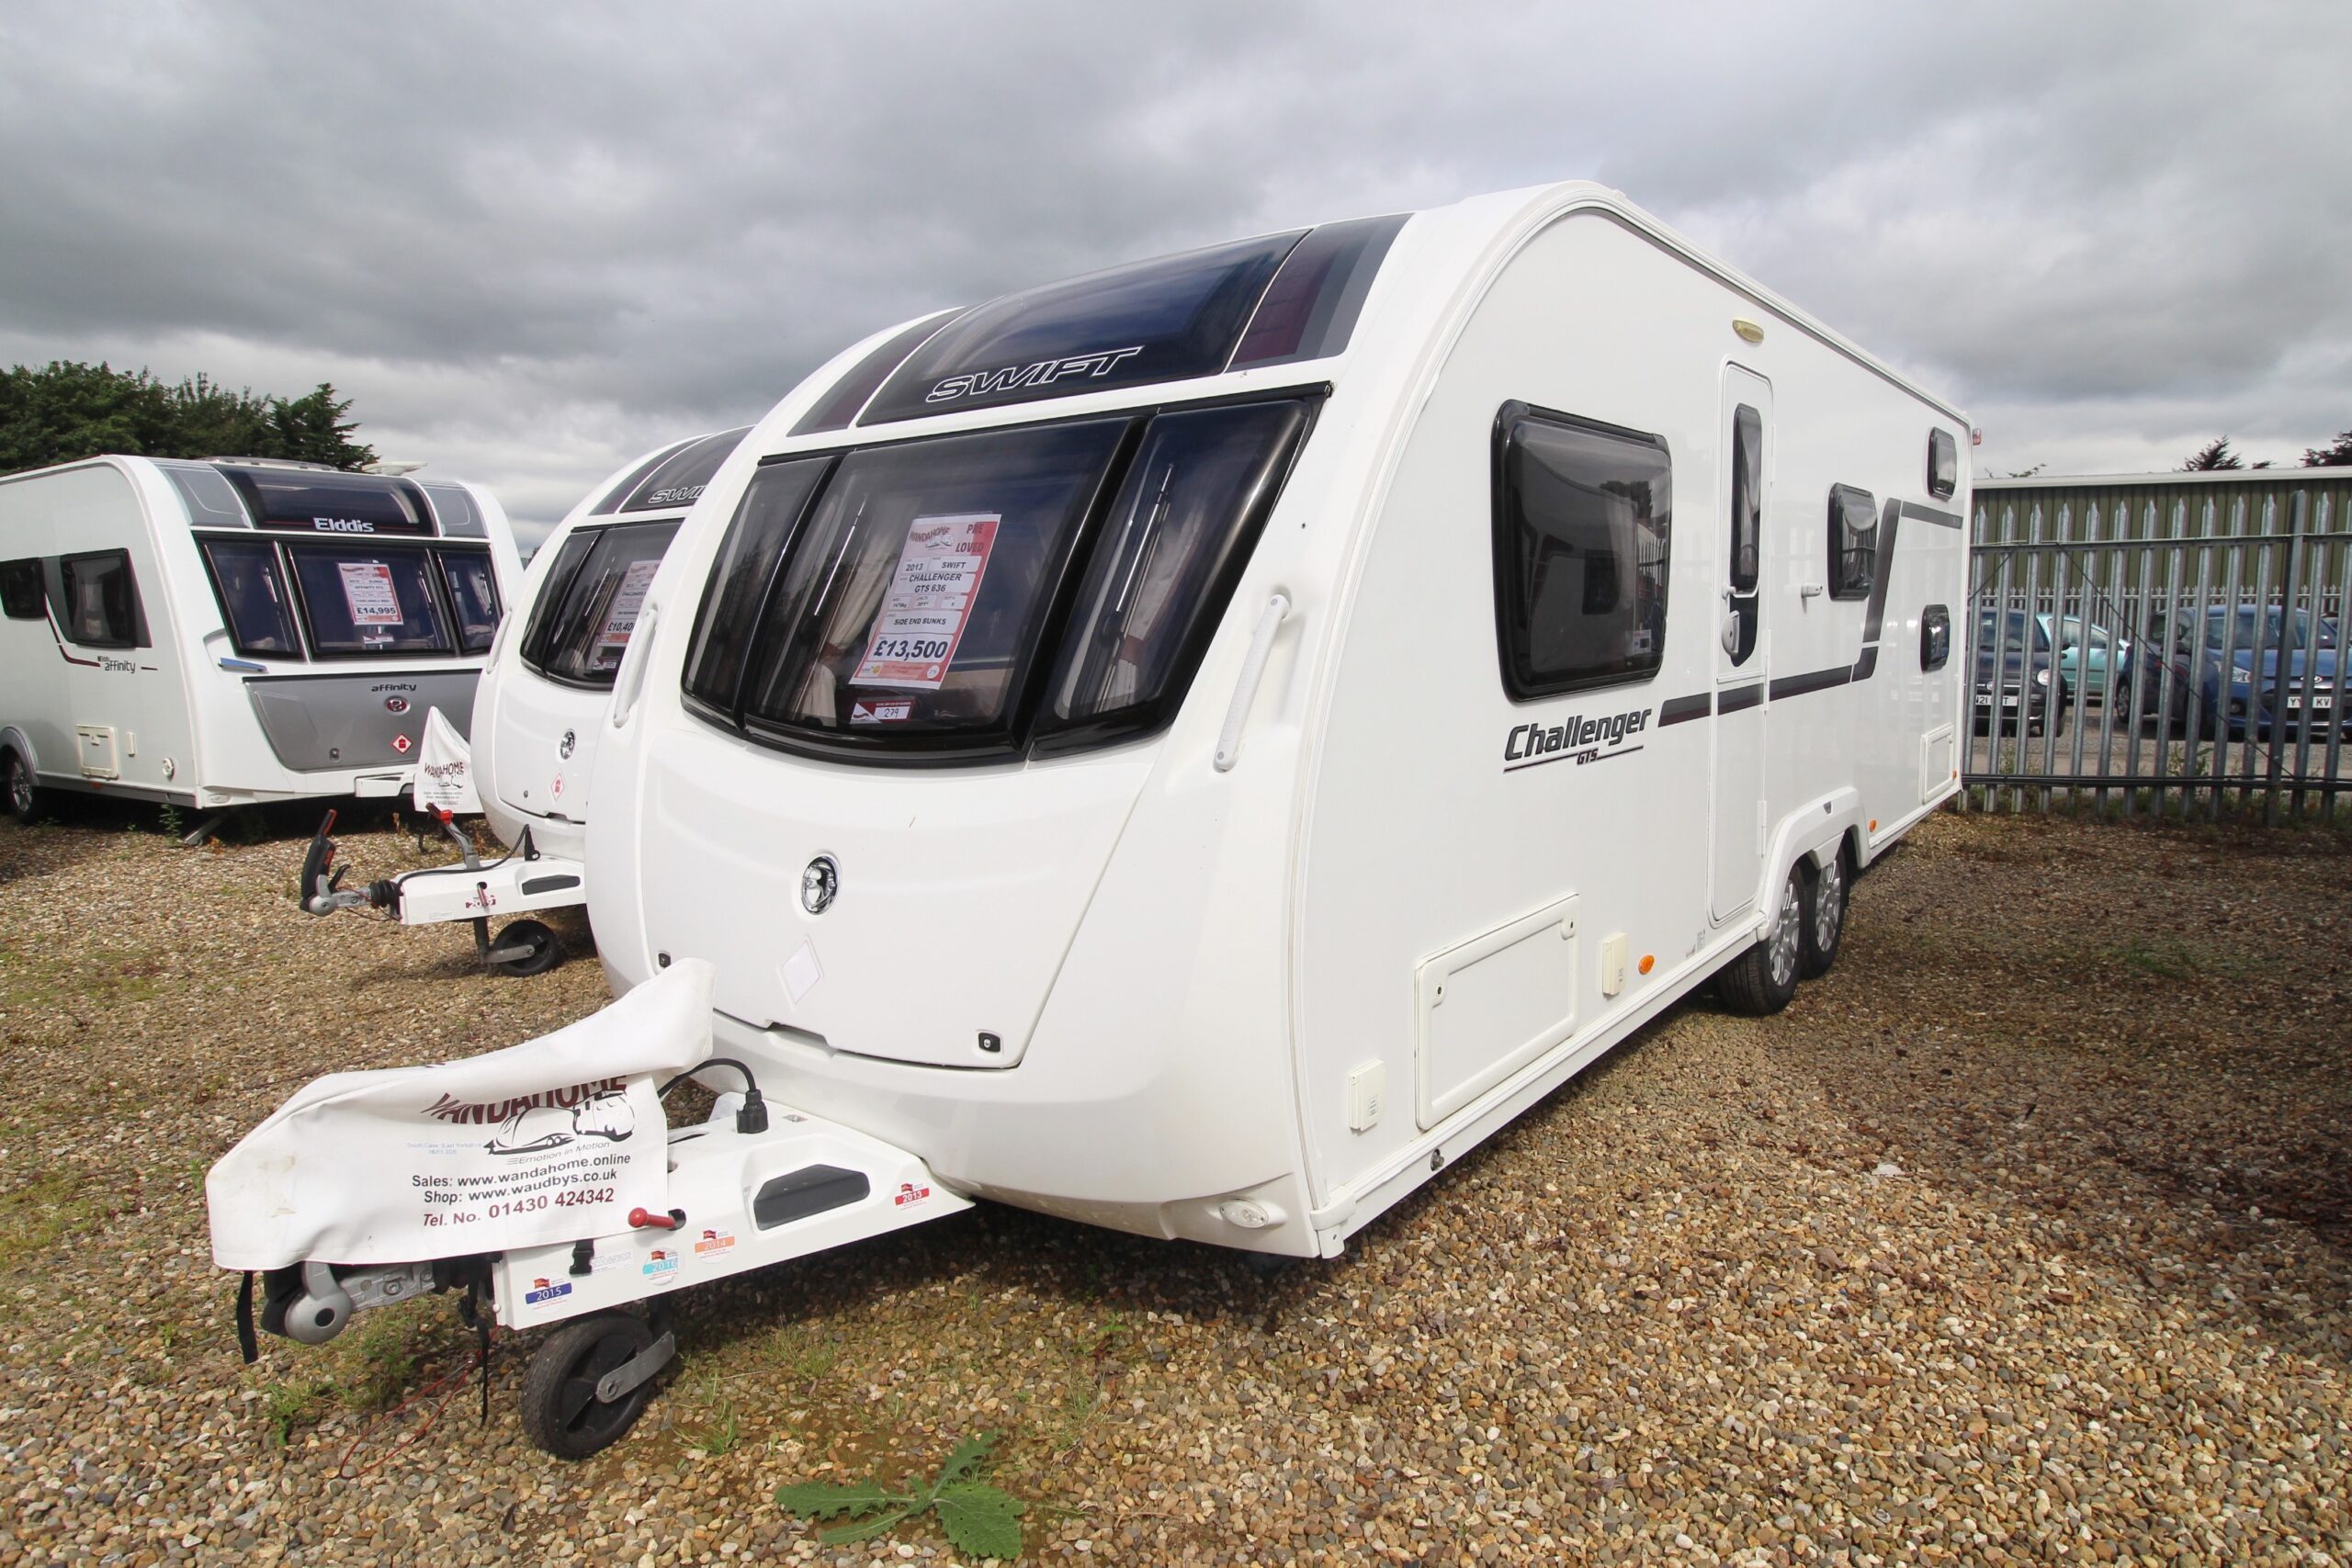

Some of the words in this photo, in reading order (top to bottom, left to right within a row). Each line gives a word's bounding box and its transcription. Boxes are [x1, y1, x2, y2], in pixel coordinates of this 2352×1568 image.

[925, 345, 1146, 402] SWIFT
[648, 485, 706, 503] SWI
[313, 517, 375, 533] Elddis
[967, 524, 984, 534] PRE
[956, 542, 984, 552] LOVED
[905, 563, 923, 571] 2013
[909, 572, 962, 582] CHALLENGER
[914, 584, 930, 592] GTS
[931, 584, 946, 592] 636
[356, 607, 396, 615] £14,995
[607, 622, 634, 632] £10,40
[873, 639, 948, 660] £13,500
[105, 660, 136, 674] affinity
[371, 683, 417, 692] affinity
[1504, 708, 1652, 761] Challenger
[1577, 748, 1599, 765] GTS
[518, 1151, 561, 1164] Emotion
[576, 1142, 610, 1152] Motion
[412, 1175, 453, 1187] Sales:
[458, 1154, 631, 1187] www.wandahome.online
[424, 1190, 462, 1205] Shop:
[469, 1168, 617, 1201] www.waudbys.co.uk
[903, 1190, 922, 1203] 2013
[423, 1213, 447, 1226] Tel.
[453, 1213, 481, 1224] No.
[488, 1195, 548, 1218] 01430
[555, 1188, 615, 1207] 424342
[705, 1239, 726, 1250] 2014
[653, 1259, 677, 1272] 2016
[537, 1287, 562, 1301] 2015
